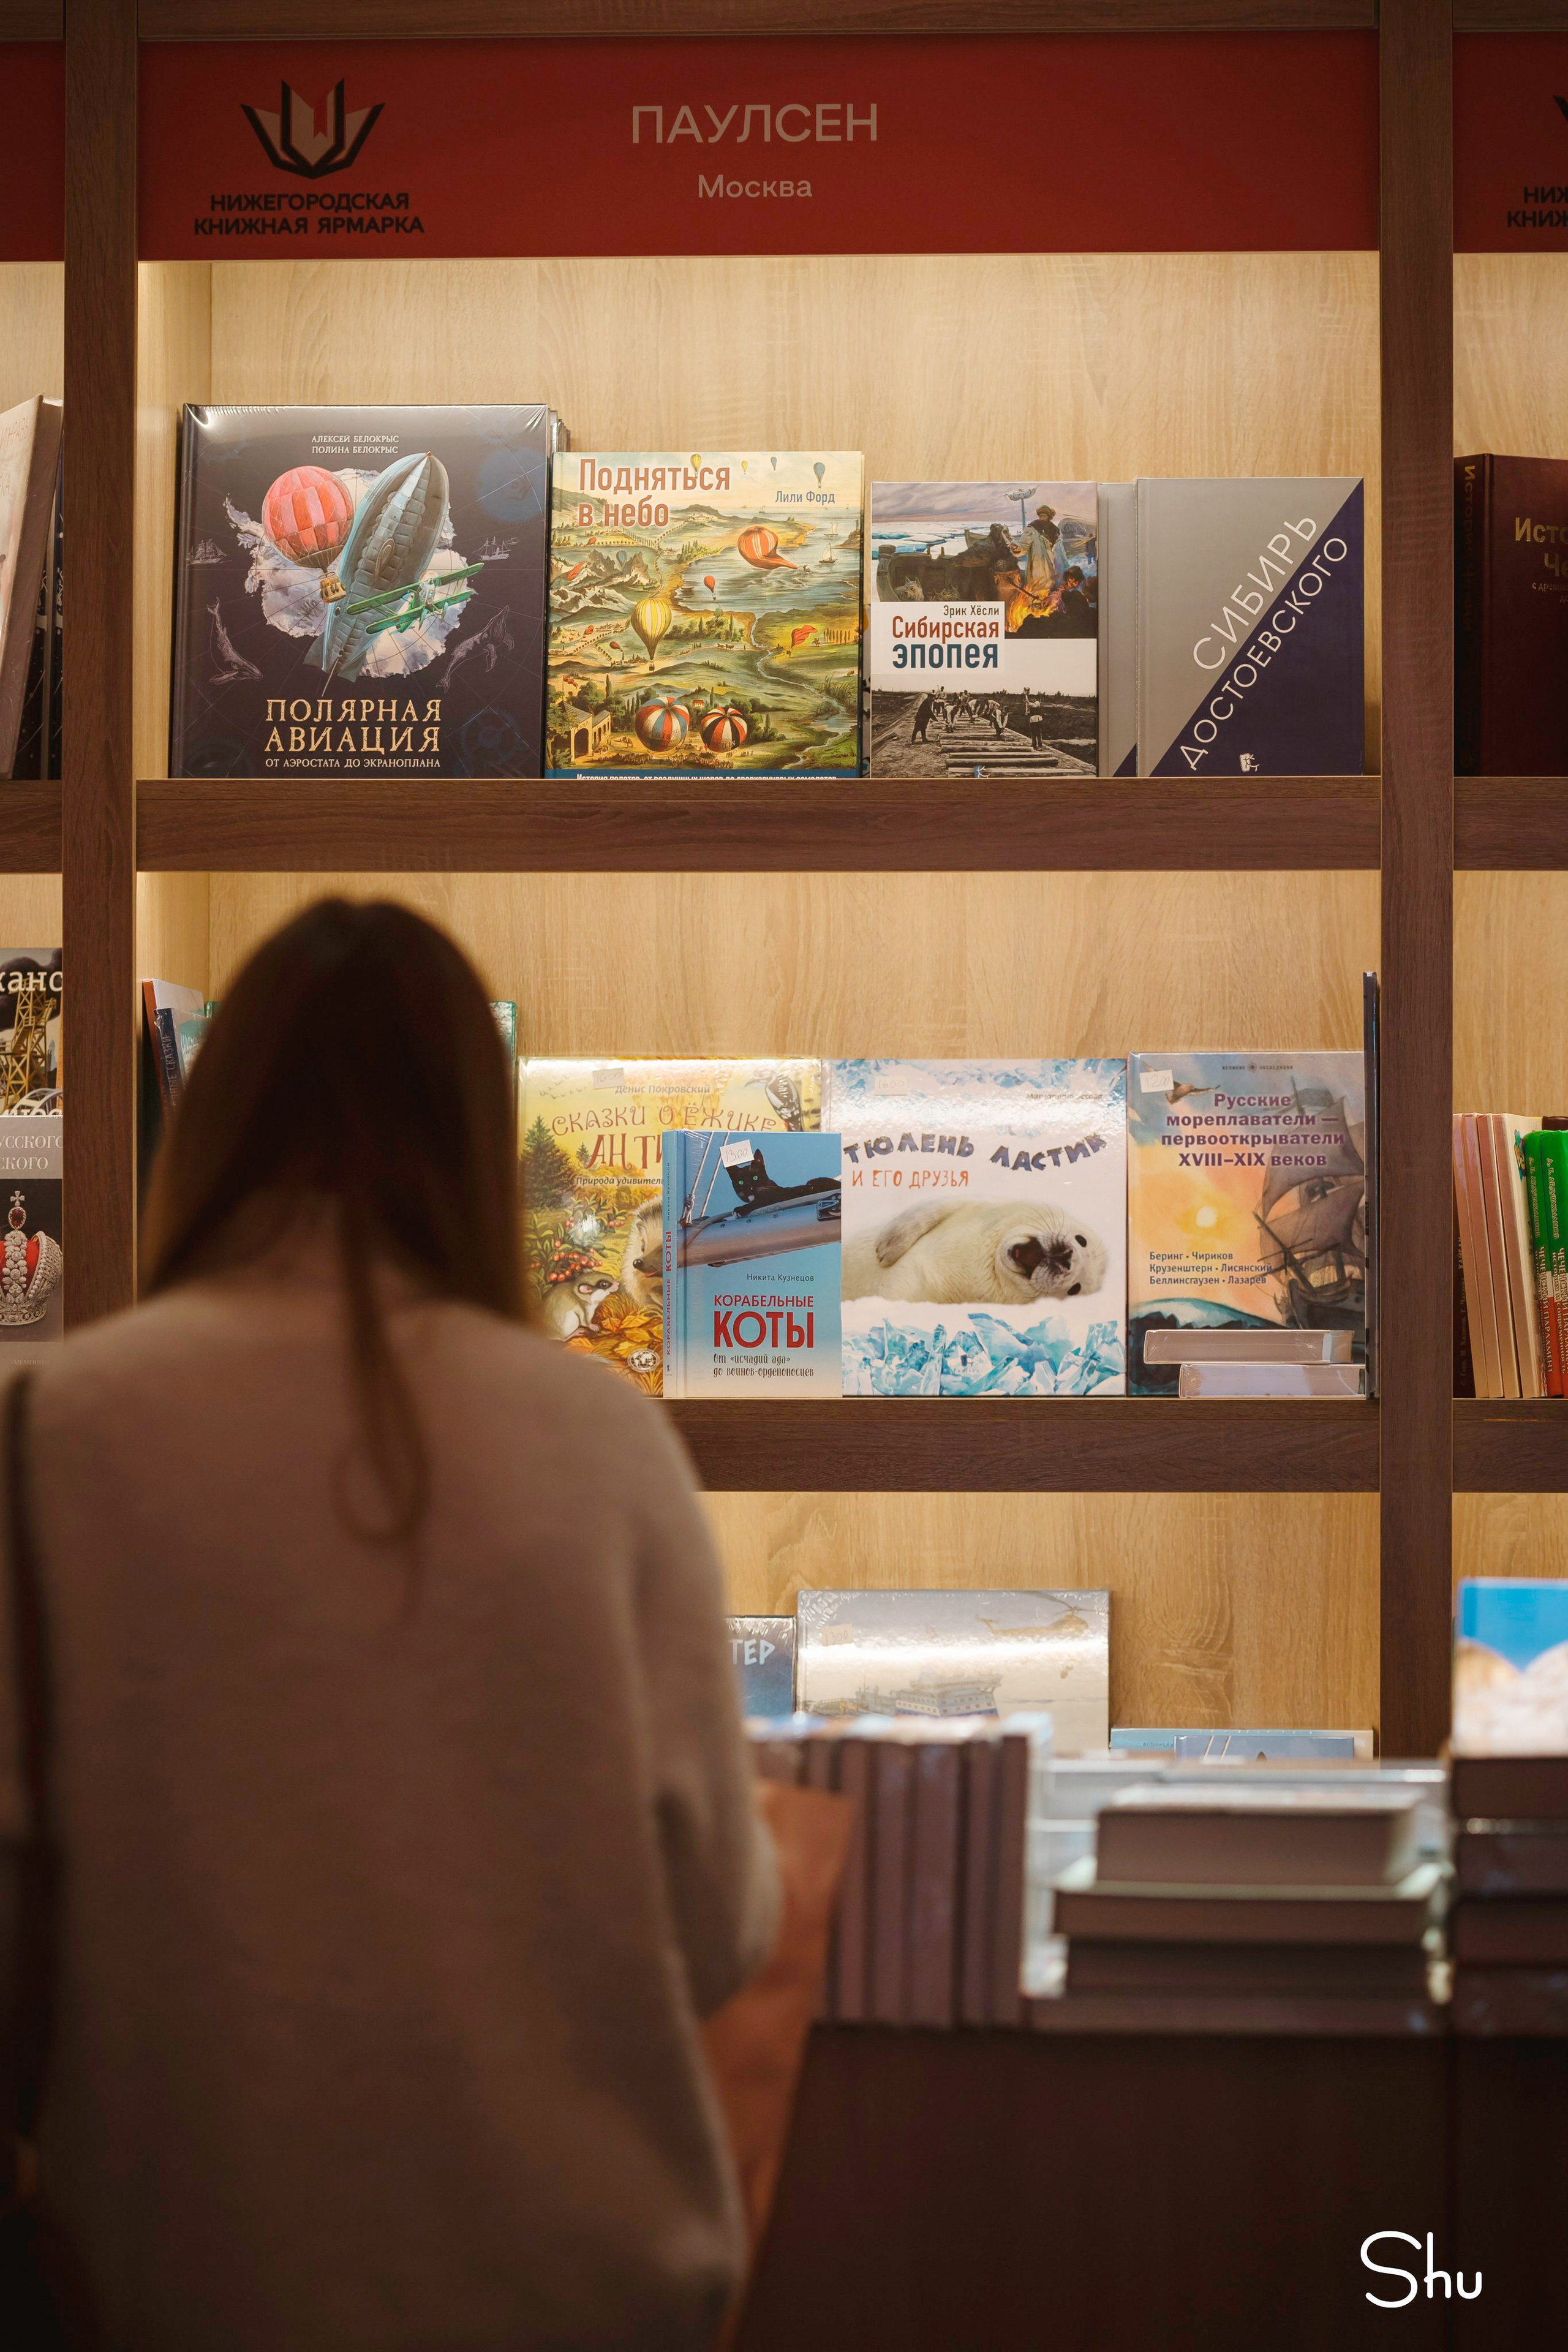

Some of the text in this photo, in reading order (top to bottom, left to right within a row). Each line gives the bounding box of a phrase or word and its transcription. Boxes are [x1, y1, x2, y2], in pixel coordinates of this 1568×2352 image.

[632, 103, 878, 144] ПАУЛСЕН
[698, 175, 813, 198] Москва
[210, 192, 409, 213] НИЖЕГОРОДСКАЯ
[194, 216, 425, 236] КНИЖНАЯ ЯРМАРКА
[311, 434, 399, 443] АЛЕКСЕЙ БЕЛОКРЫС
[579, 458, 731, 495] Подняться
[775, 491, 835, 504] Лили Форд
[578, 495, 669, 527] в небо
[1194, 518, 1317, 669] СИБИРЬ
[943, 605, 1000, 617] Эрик Хёсли
[892, 616, 1000, 644] Сибирская
[892, 644, 998, 668] эпопея
[1180, 538, 1348, 771] ДОСТОЕВСКОГО
[265, 698, 442, 722] ПОЛЯРНАЯ
[264, 727, 441, 755] АВИАЦИЯ
[344, 759, 361, 769] ДО
[162, 1036, 175, 1070] СКАЗКИ
[614, 1083, 710, 1095] Денис Покровский
[1213, 1093, 1292, 1110] Русские
[552, 1101, 777, 1136] СКАЗКИ О ЁЖИКЕ
[1166, 1114, 1316, 1130] мореплаватели
[1161, 1133, 1344, 1149] первооткрыватели
[843, 1132, 1107, 1172] ТЮЛЕНЬ ЛАСТИК
[1271, 1153, 1327, 1167] веков
[576, 1175, 614, 1187] Природа
[852, 1170, 969, 1189] И ЕГО ДРУЗЬЯ
[1150, 1251, 1233, 1262] Беринг Чириков
[1150, 1262, 1272, 1274] Крузенштерн Лисянский
[1539, 1246, 1551, 1309] ЧЕЧЕНСКИЙ
[778, 1273, 814, 1283] Кузнецов
[1150, 1275, 1267, 1286] Беллинсгаузен Лазарев
[714, 1294, 814, 1308] КОРАБЕЛЬНЫЕ
[714, 1311, 814, 1348] КОТЫ
[1544, 1311, 1553, 1373] ПАРЛАМЕНТ
[714, 1353, 791, 1365] От «исчадий ада»
[714, 1367, 814, 1378] до воинов-орденоносцев
